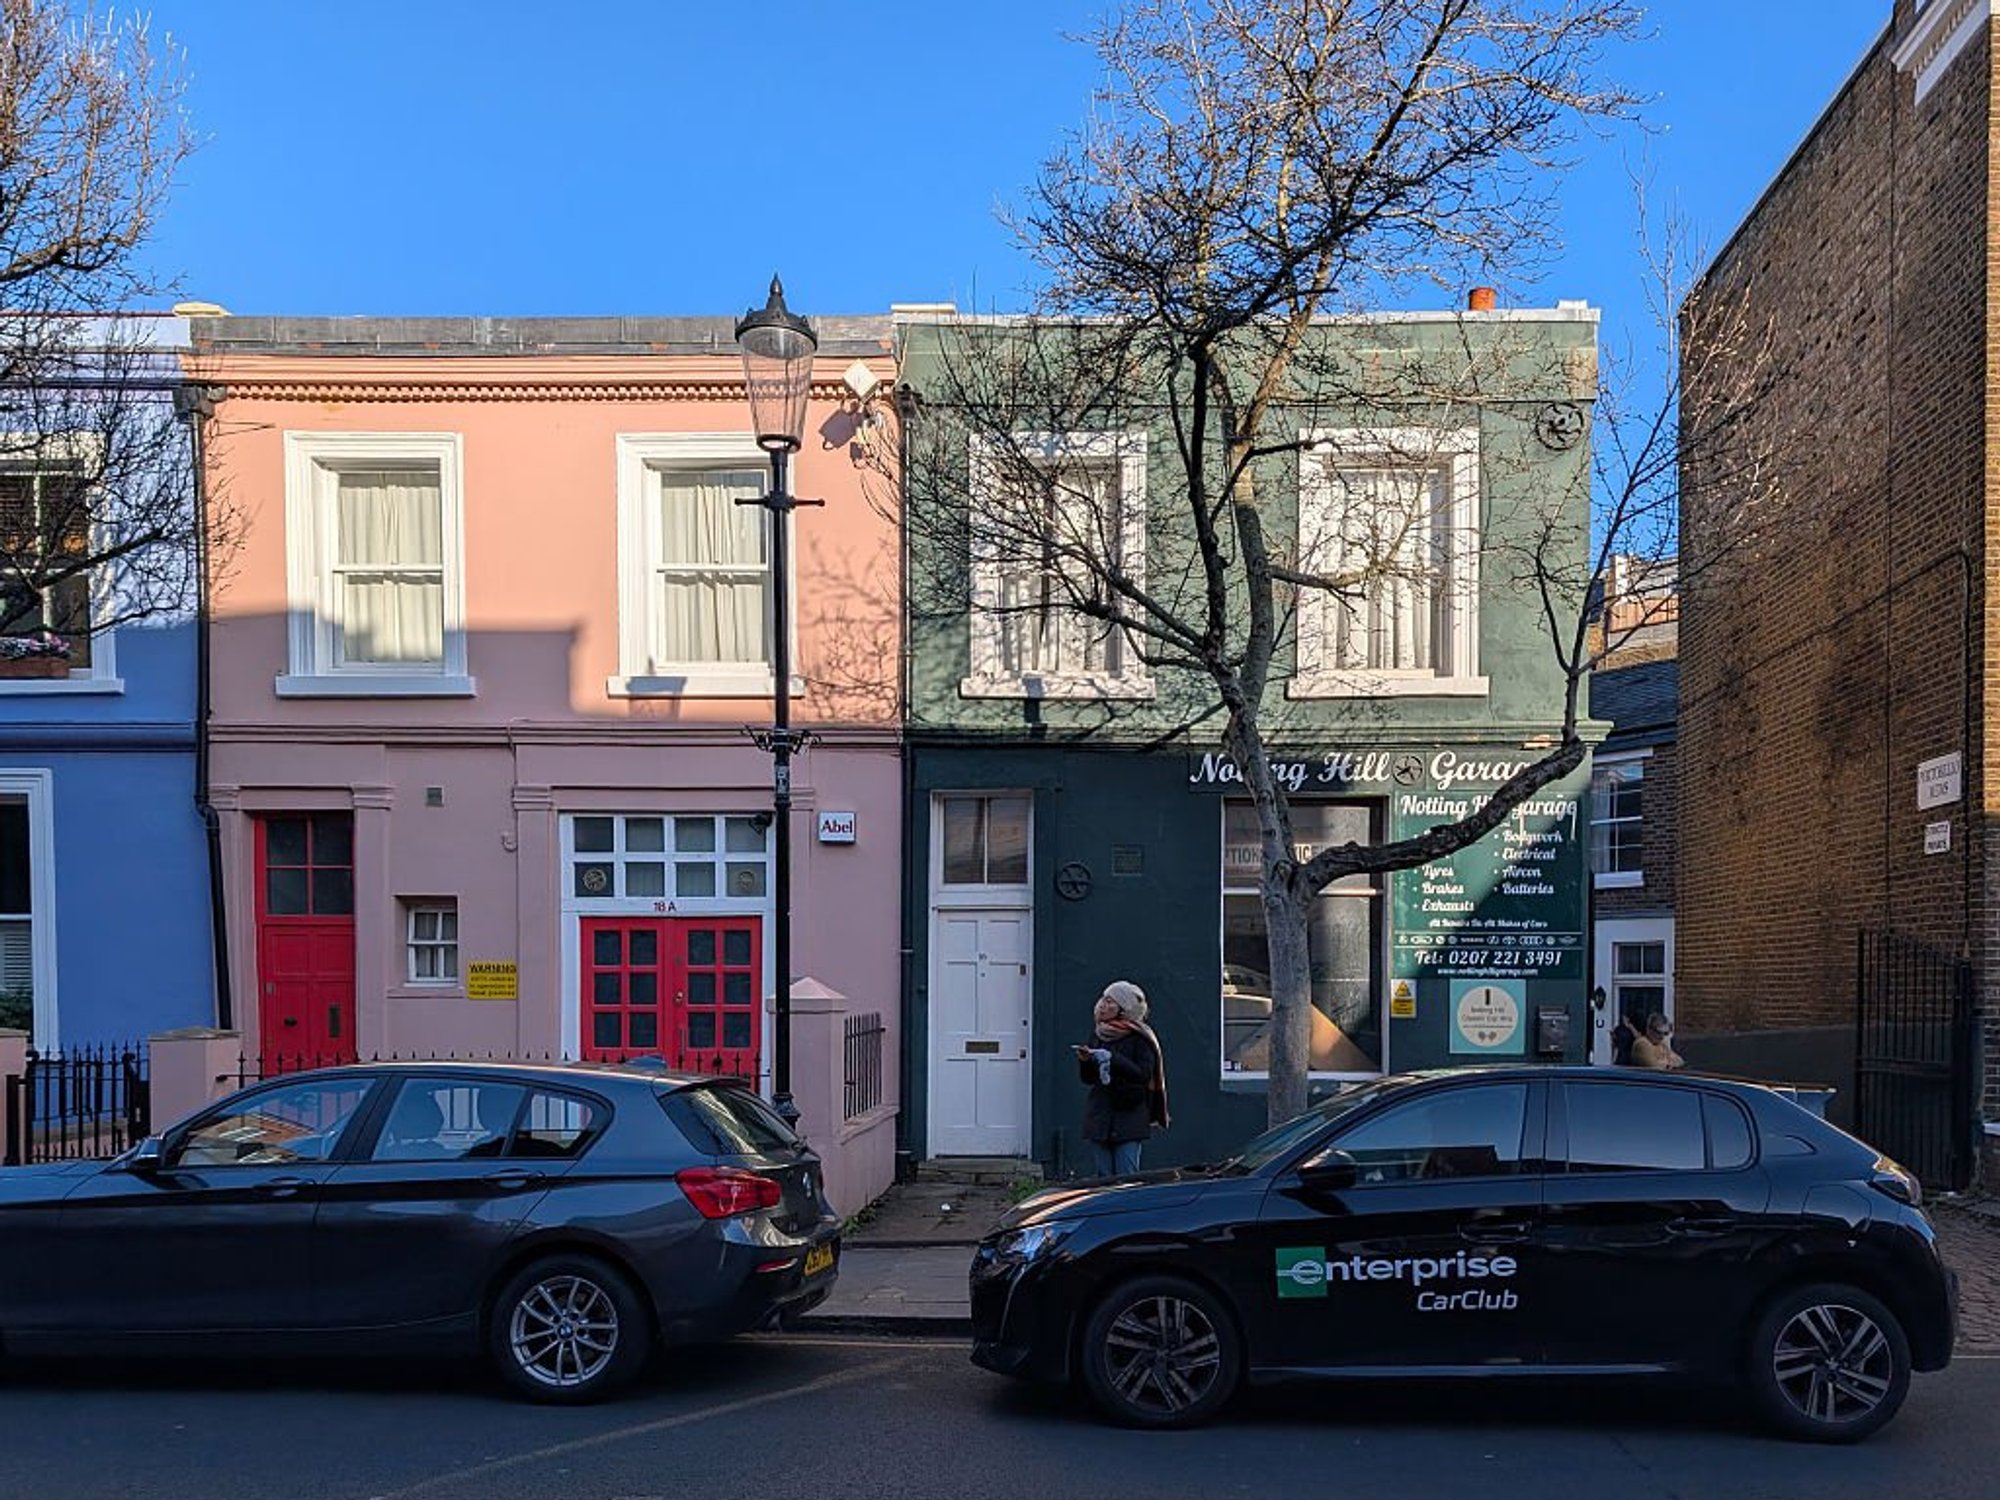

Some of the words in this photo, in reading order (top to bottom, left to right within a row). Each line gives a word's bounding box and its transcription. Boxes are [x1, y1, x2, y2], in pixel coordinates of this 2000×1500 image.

[1189, 751, 1309, 792] Nong
[1318, 751, 1391, 783] Hill
[1430, 751, 1531, 791] Gara
[1400, 794, 1468, 823] Notting
[820, 819, 853, 833] Abel
[1502, 830, 1563, 846] Bodywork
[1502, 847, 1556, 861] Electrical
[1421, 865, 1455, 880] Tyres
[1502, 865, 1542, 878] Aircon
[1421, 882, 1465, 895] Brakes
[1502, 882, 1555, 895] Batteries
[1421, 899, 1475, 912] Exhausts
[1415, 950, 1443, 965] Tel:
[1449, 951, 1486, 965] 0207
[1493, 951, 1521, 965] 221
[1525, 951, 1562, 966] 3491
[1291, 1250, 1518, 1286] enterprise
[1417, 1289, 1519, 1311] CarClub
